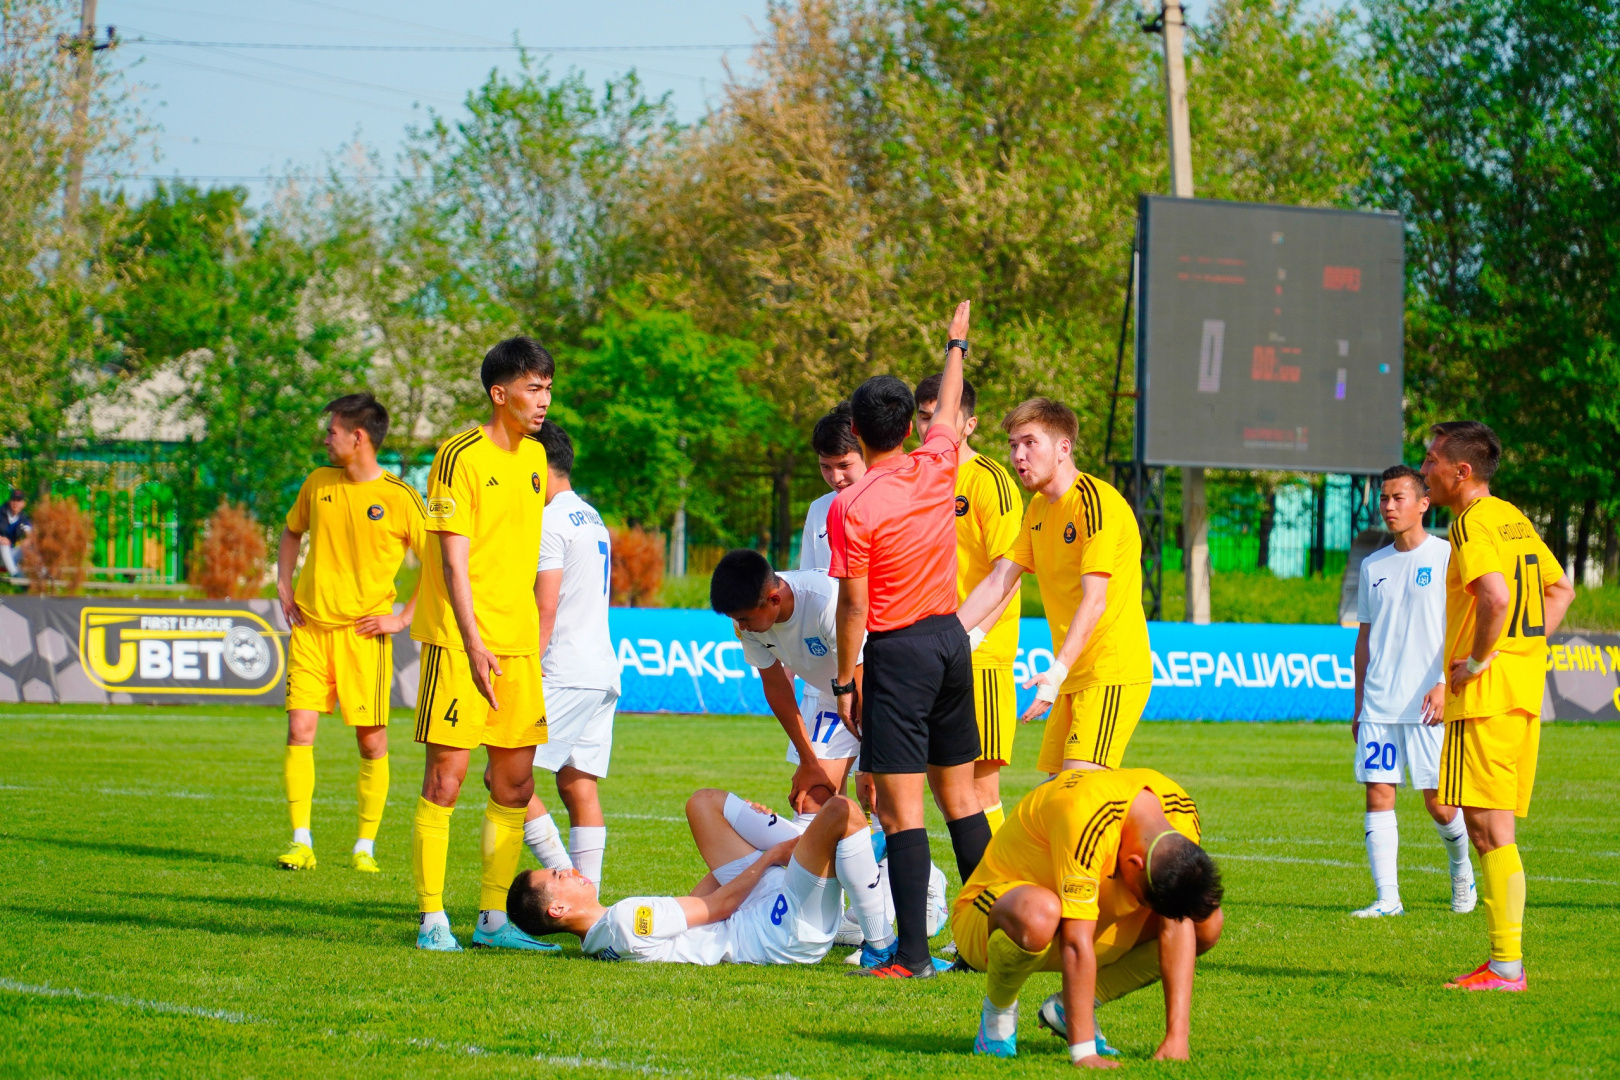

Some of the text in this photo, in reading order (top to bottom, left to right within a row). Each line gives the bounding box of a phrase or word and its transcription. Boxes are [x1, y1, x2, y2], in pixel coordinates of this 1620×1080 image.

[598, 540, 609, 597] 7
[1507, 554, 1546, 638] 10
[140, 615, 233, 632] FIRST LEAGUE
[617, 637, 758, 685] АЗАҚС
[1151, 650, 1355, 690] ДЕРАЦИЯСЫ
[443, 697, 459, 728] 4
[811, 710, 842, 744] 17
[1364, 741, 1397, 771] 20
[770, 893, 789, 926] 8
